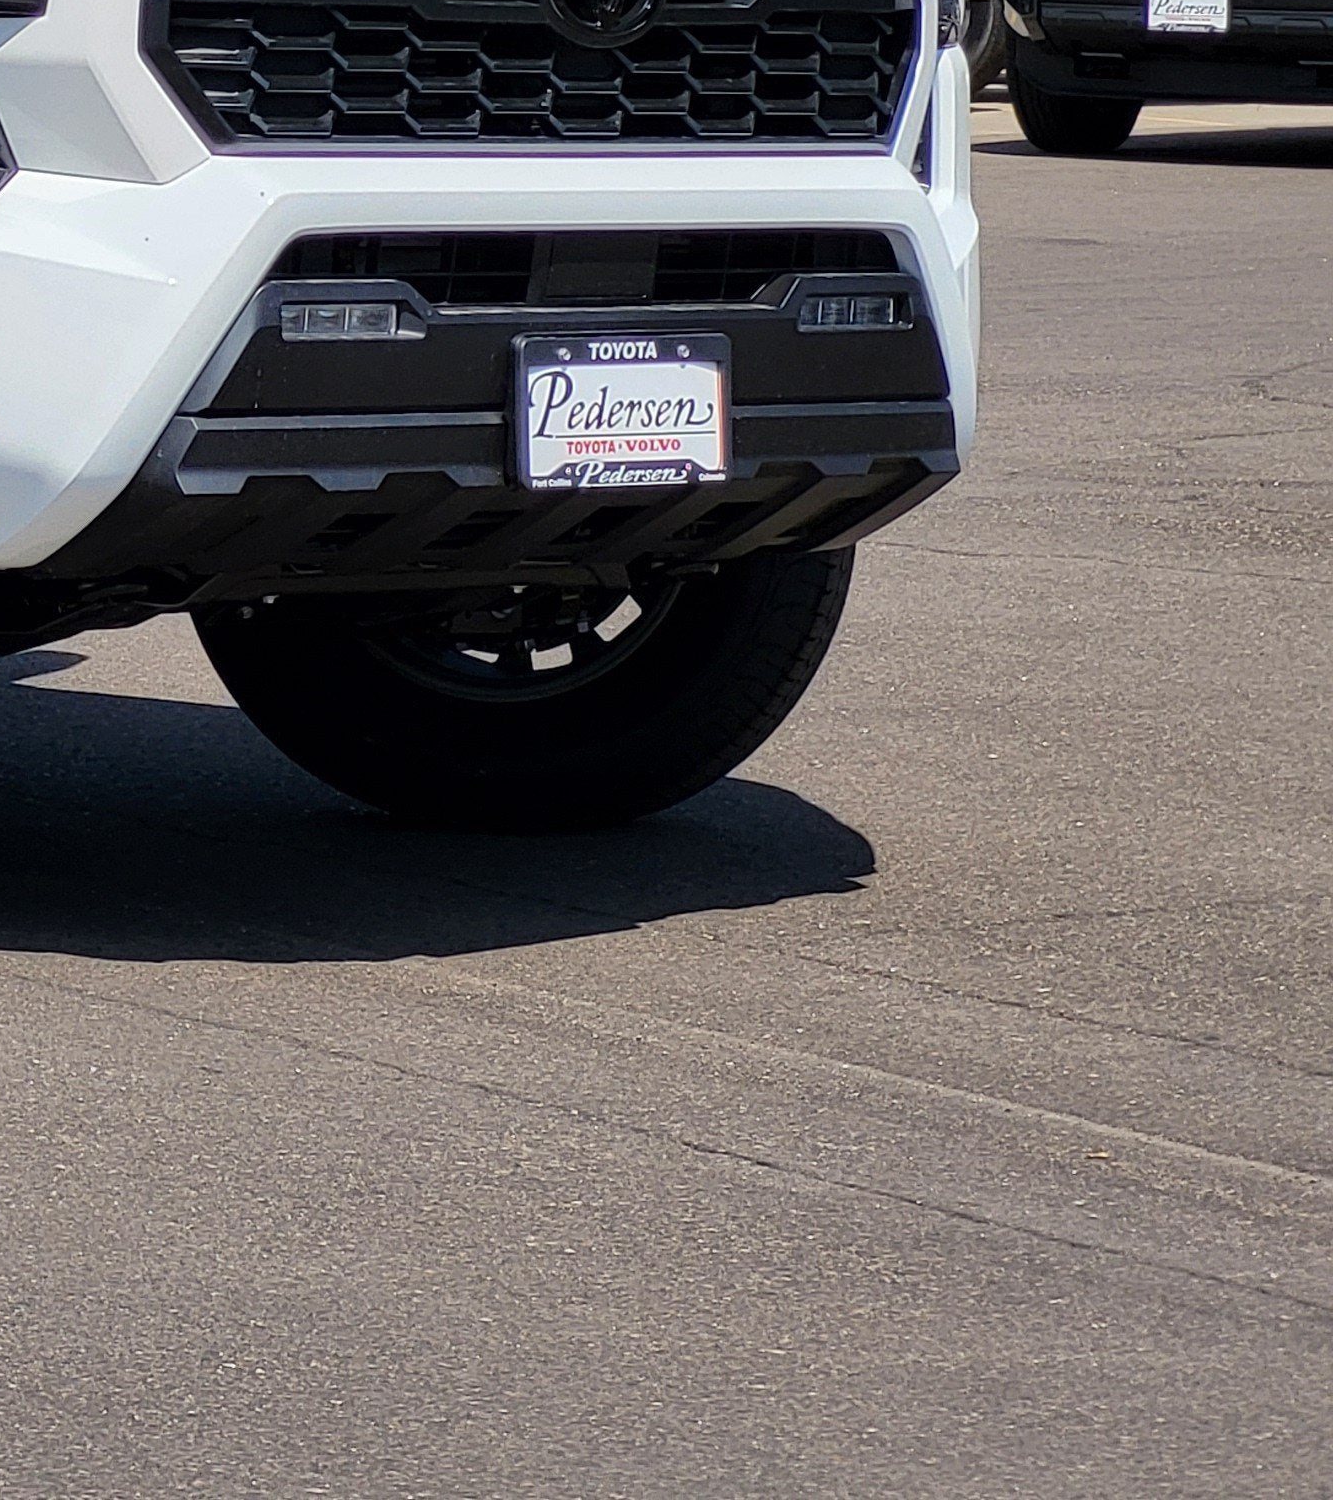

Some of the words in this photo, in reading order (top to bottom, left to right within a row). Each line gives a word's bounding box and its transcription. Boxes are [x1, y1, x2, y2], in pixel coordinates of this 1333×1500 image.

[588, 341, 658, 360] TOYOTA
[529, 370, 714, 438] Pedersen
[566, 441, 616, 455] TOYOTA
[624, 438, 681, 452] VOLVO
[575, 460, 687, 486] Pedersen
